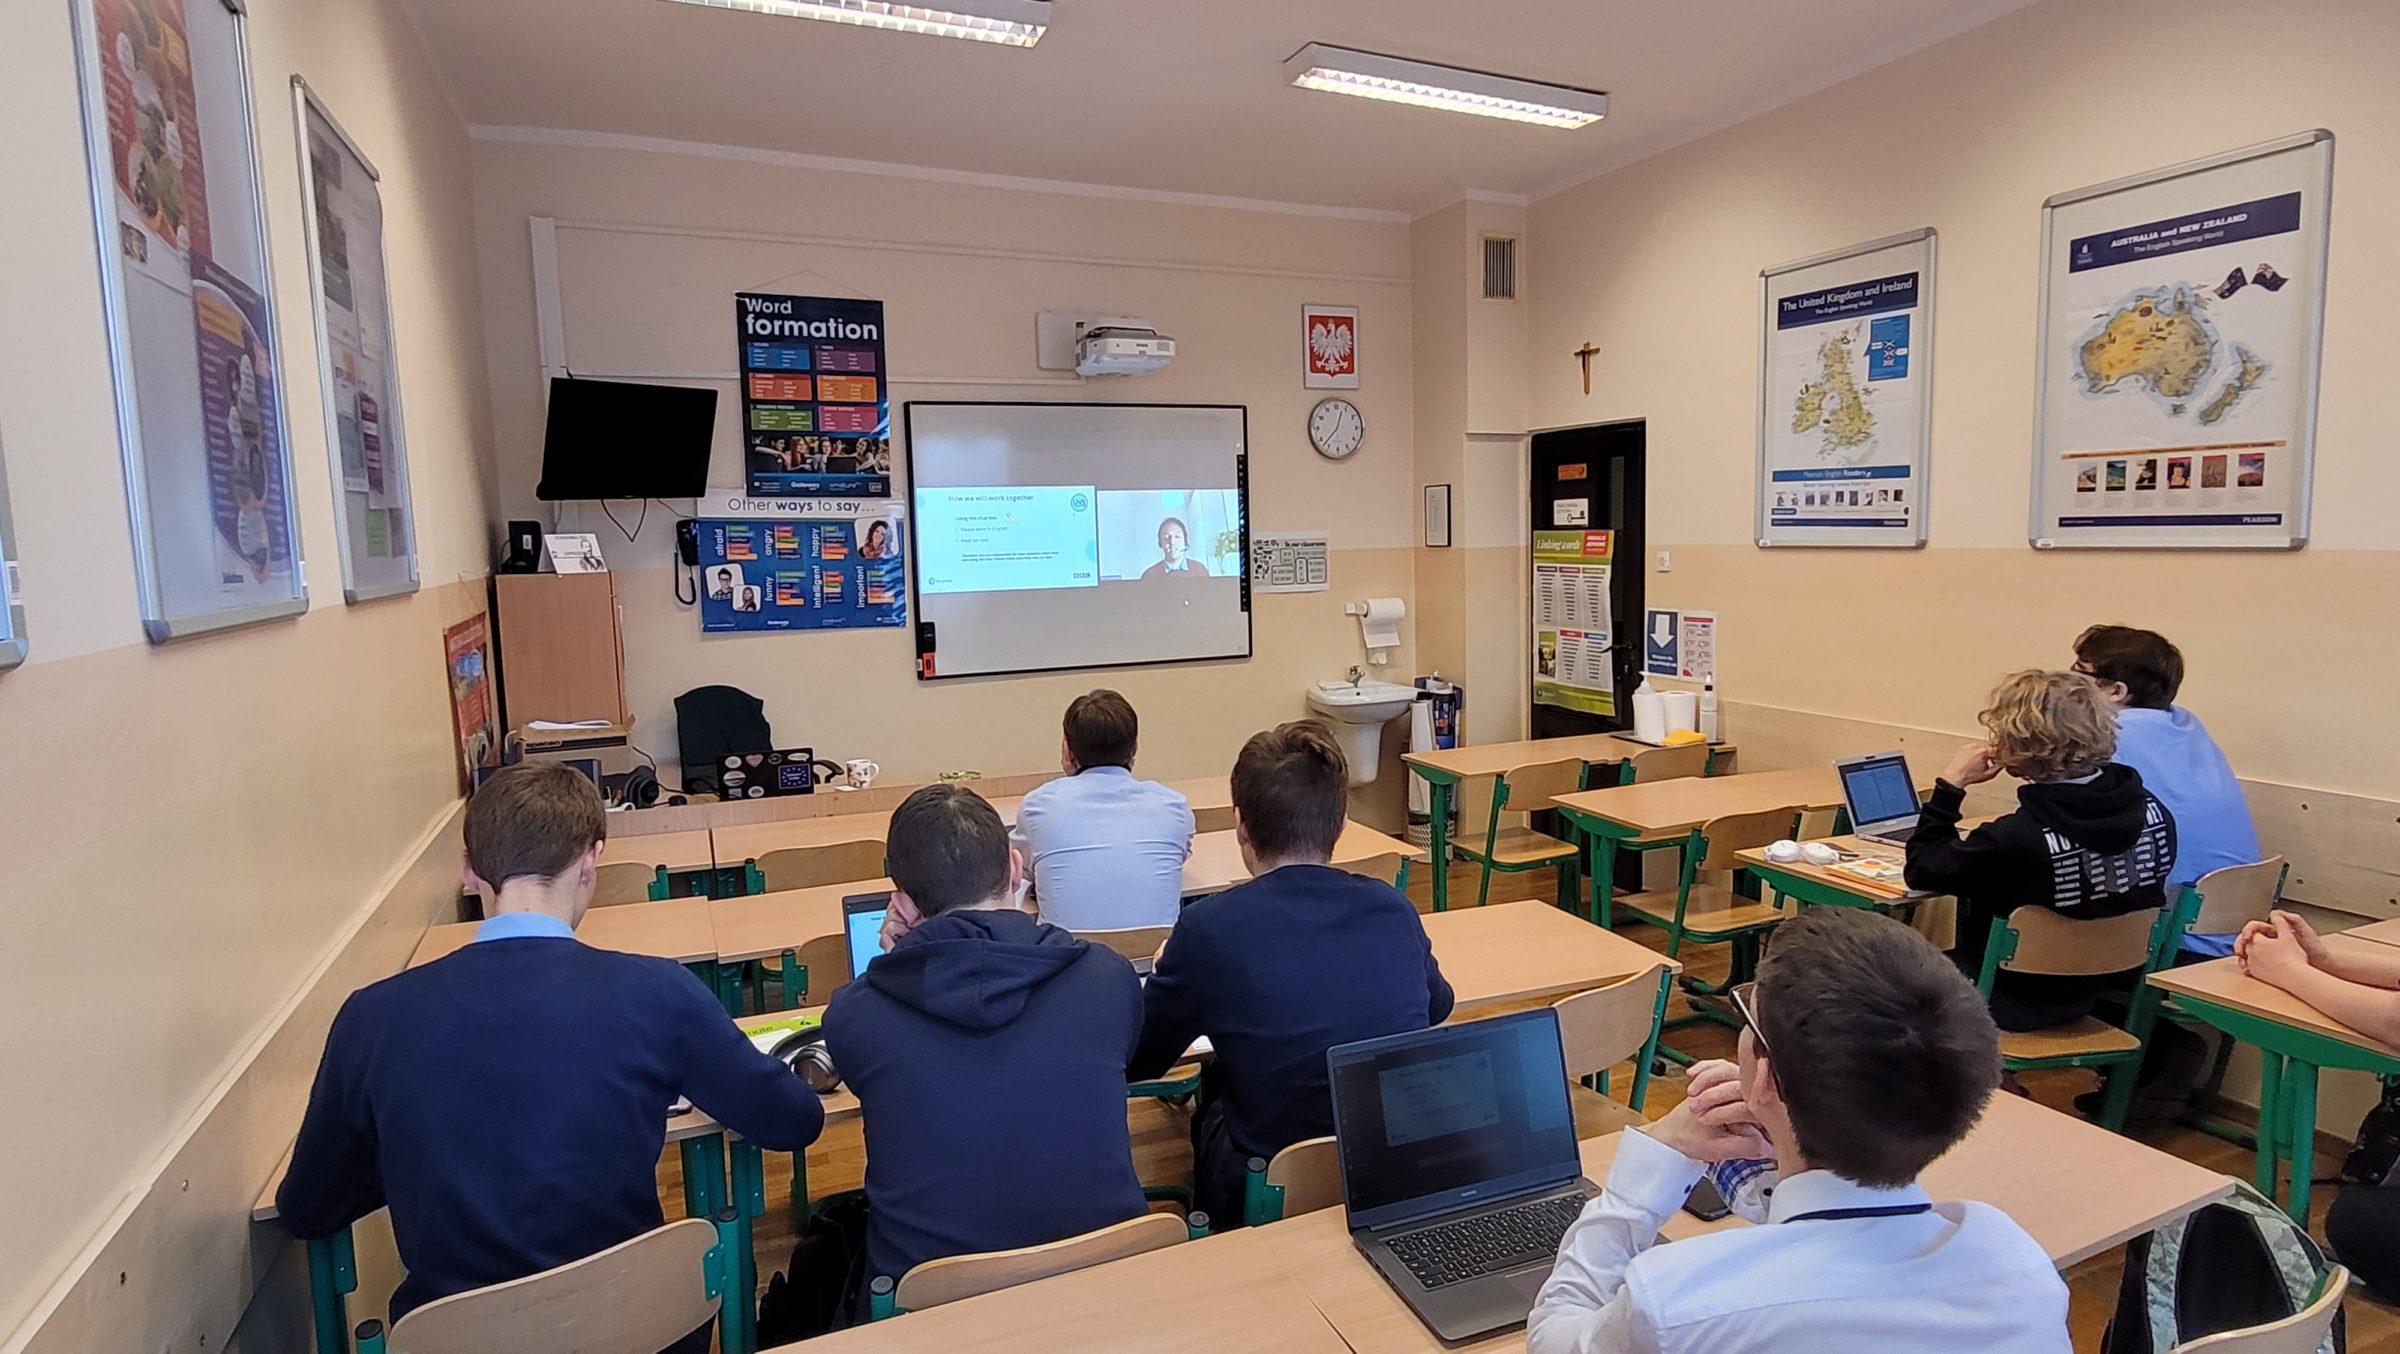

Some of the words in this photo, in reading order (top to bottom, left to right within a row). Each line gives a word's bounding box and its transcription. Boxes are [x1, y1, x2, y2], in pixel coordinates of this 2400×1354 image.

[2110, 231, 2158, 248] AUSTRALIA
[2160, 228, 2178, 238] and
[2179, 222, 2201, 234] NEW
[2202, 213, 2248, 229] ZEALAND
[746, 298, 792, 314] Word
[1782, 302, 1798, 312] The
[1798, 294, 1826, 308] United
[1826, 290, 1864, 304] Kingdom
[1864, 285, 1880, 296] and
[1882, 278, 1913, 293] Ireland
[746, 314, 878, 340] formation
[728, 498, 771, 512] Other
[776, 501, 814, 514] ways
[818, 500, 832, 512] to
[715, 528, 724, 556] afraid
[765, 529, 774, 556] angry
[811, 528, 821, 557] happy
[765, 576, 774, 602] funny
